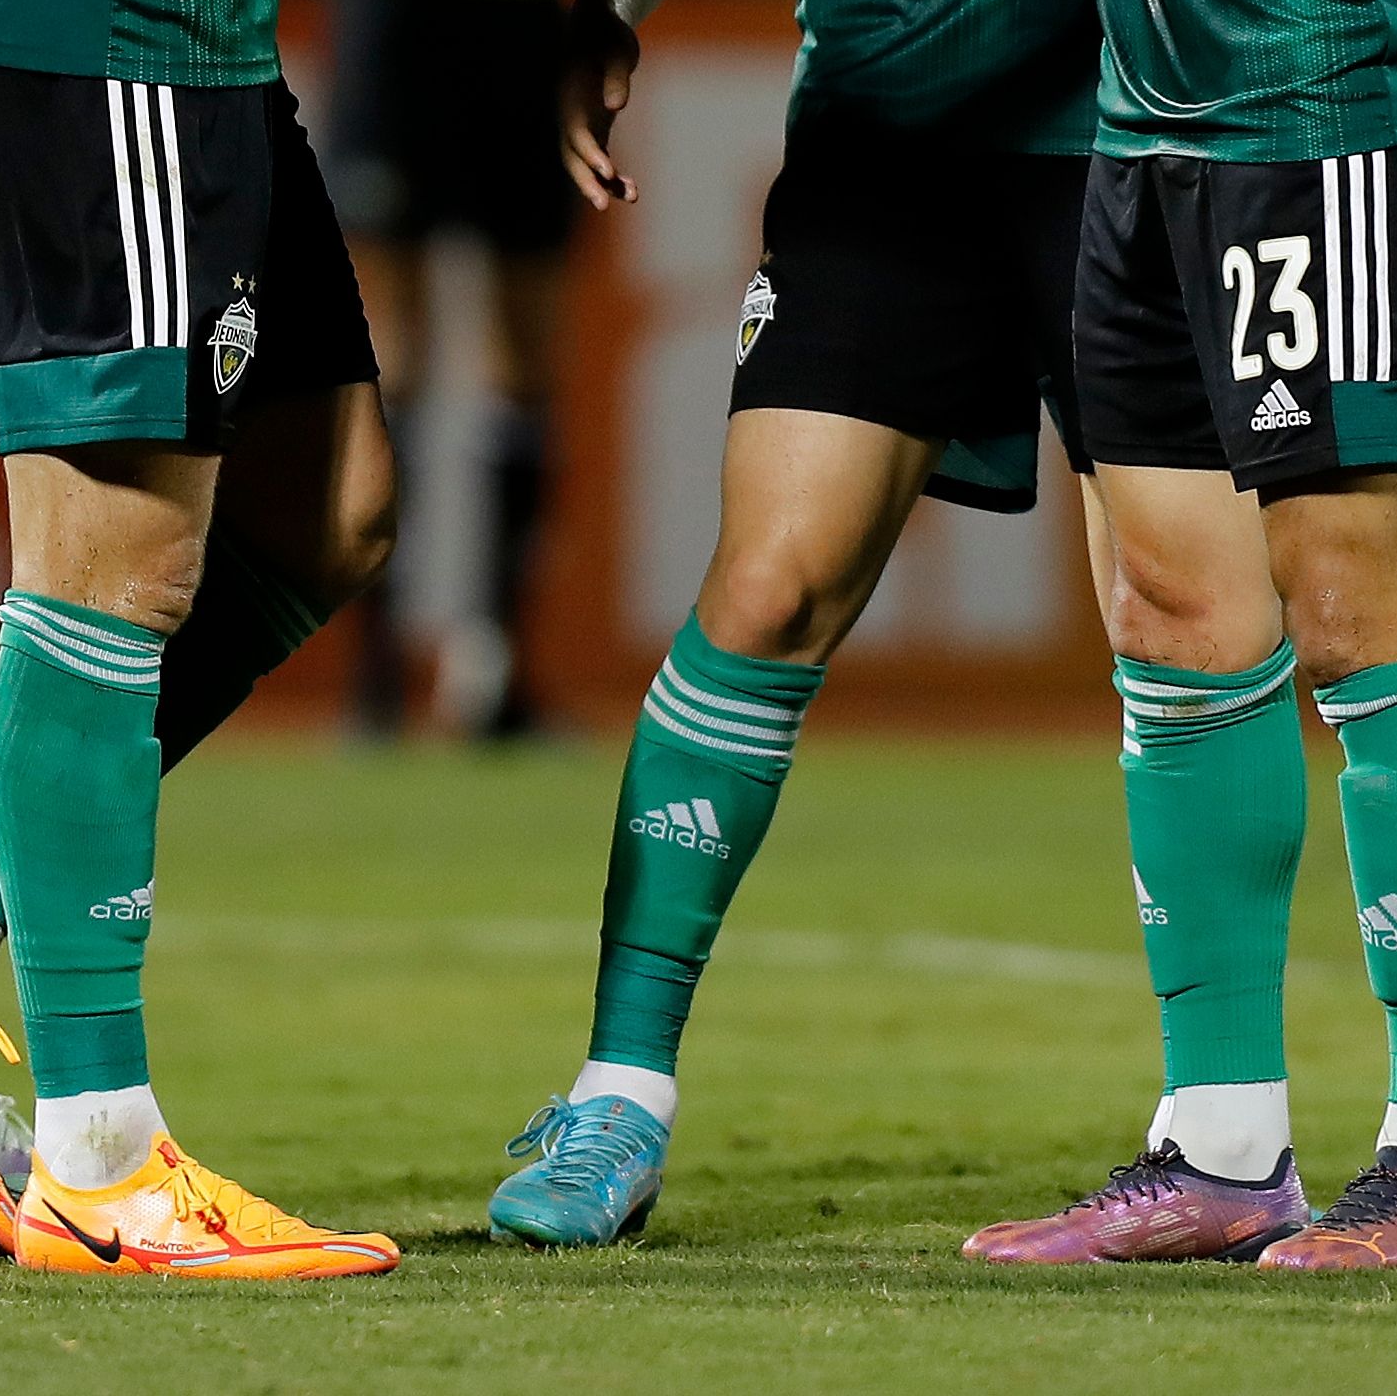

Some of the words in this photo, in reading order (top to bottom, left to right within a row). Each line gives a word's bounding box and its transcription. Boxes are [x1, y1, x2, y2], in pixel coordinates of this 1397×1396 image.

[1222, 236, 1318, 381] 23
[1251, 408, 1312, 432] adidas
[629, 816, 732, 860] adidas
